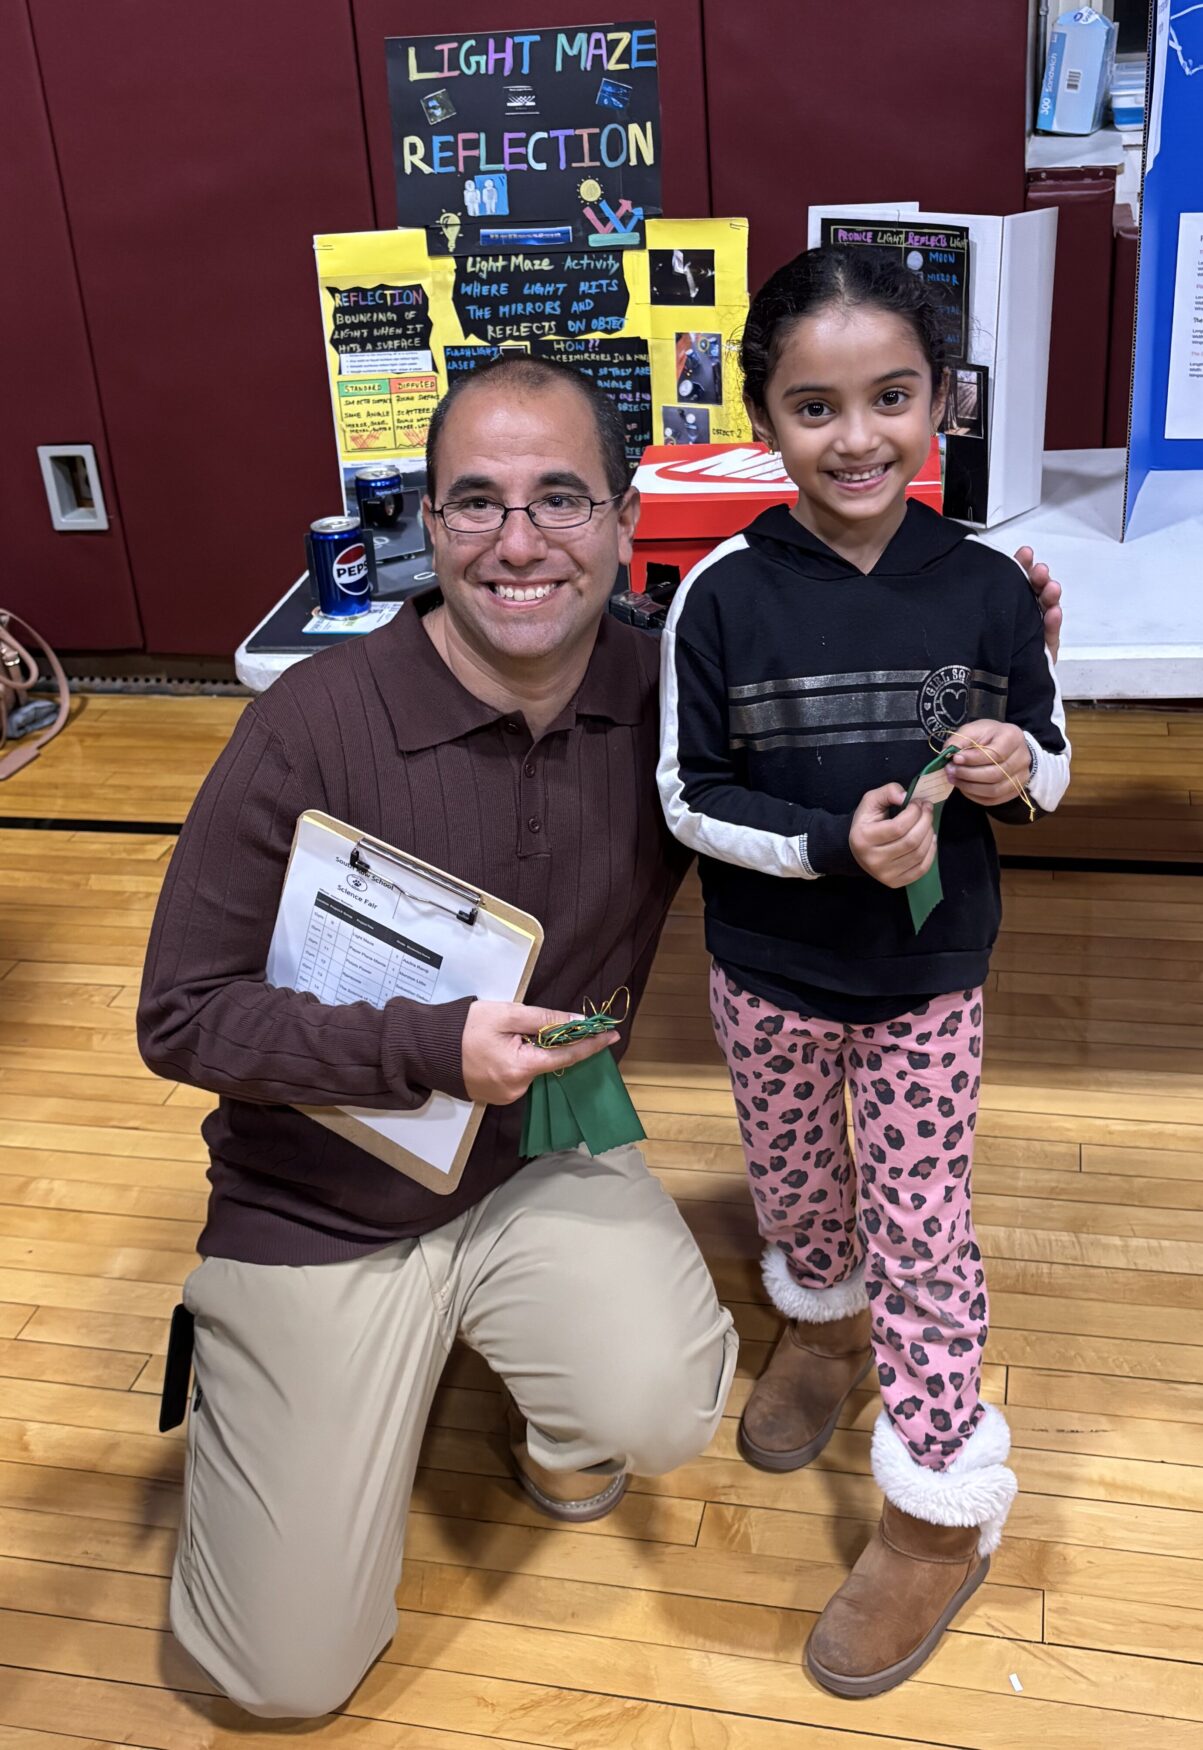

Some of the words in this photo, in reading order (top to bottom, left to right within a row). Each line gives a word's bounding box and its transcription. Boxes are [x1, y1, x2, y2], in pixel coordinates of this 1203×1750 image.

[408, 35, 541, 81] LIGHT
[555, 29, 657, 72] MAZE
[403, 121, 654, 175] REFLECTION
[466, 255, 507, 279] Light
[510, 254, 554, 273] Maze
[564, 254, 620, 275] Activity
[928, 251, 955, 264] MOON
[460, 280, 509, 298] WHERE
[523, 282, 567, 296] LIGHT
[578, 279, 618, 295] HITS
[334, 289, 422, 307] REFLECTION
[336, 311, 397, 325] BOUNCING
[404, 310, 416, 320] OF
[465, 305, 491, 320] THE
[499, 300, 561, 318] MIRRORS
[571, 299, 594, 314] AND
[333, 328, 368, 339] LIGHT
[373, 326, 402, 337] WHEN
[406, 324, 424, 334] IT
[487, 320, 556, 340] REFLECTS
[567, 318, 586, 333] ON
[376, 338, 421, 350] SURFACE
[553, 341, 585, 352] HOW
[447, 360, 475, 370] LASER
[344, 384, 382, 393] STANDARD
[336, 561, 368, 579] PEPS
[926, 671, 950, 697] GIRL
[371, 875, 395, 890] School
[337, 884, 363, 902] Science
[364, 898, 378, 910] Fair
